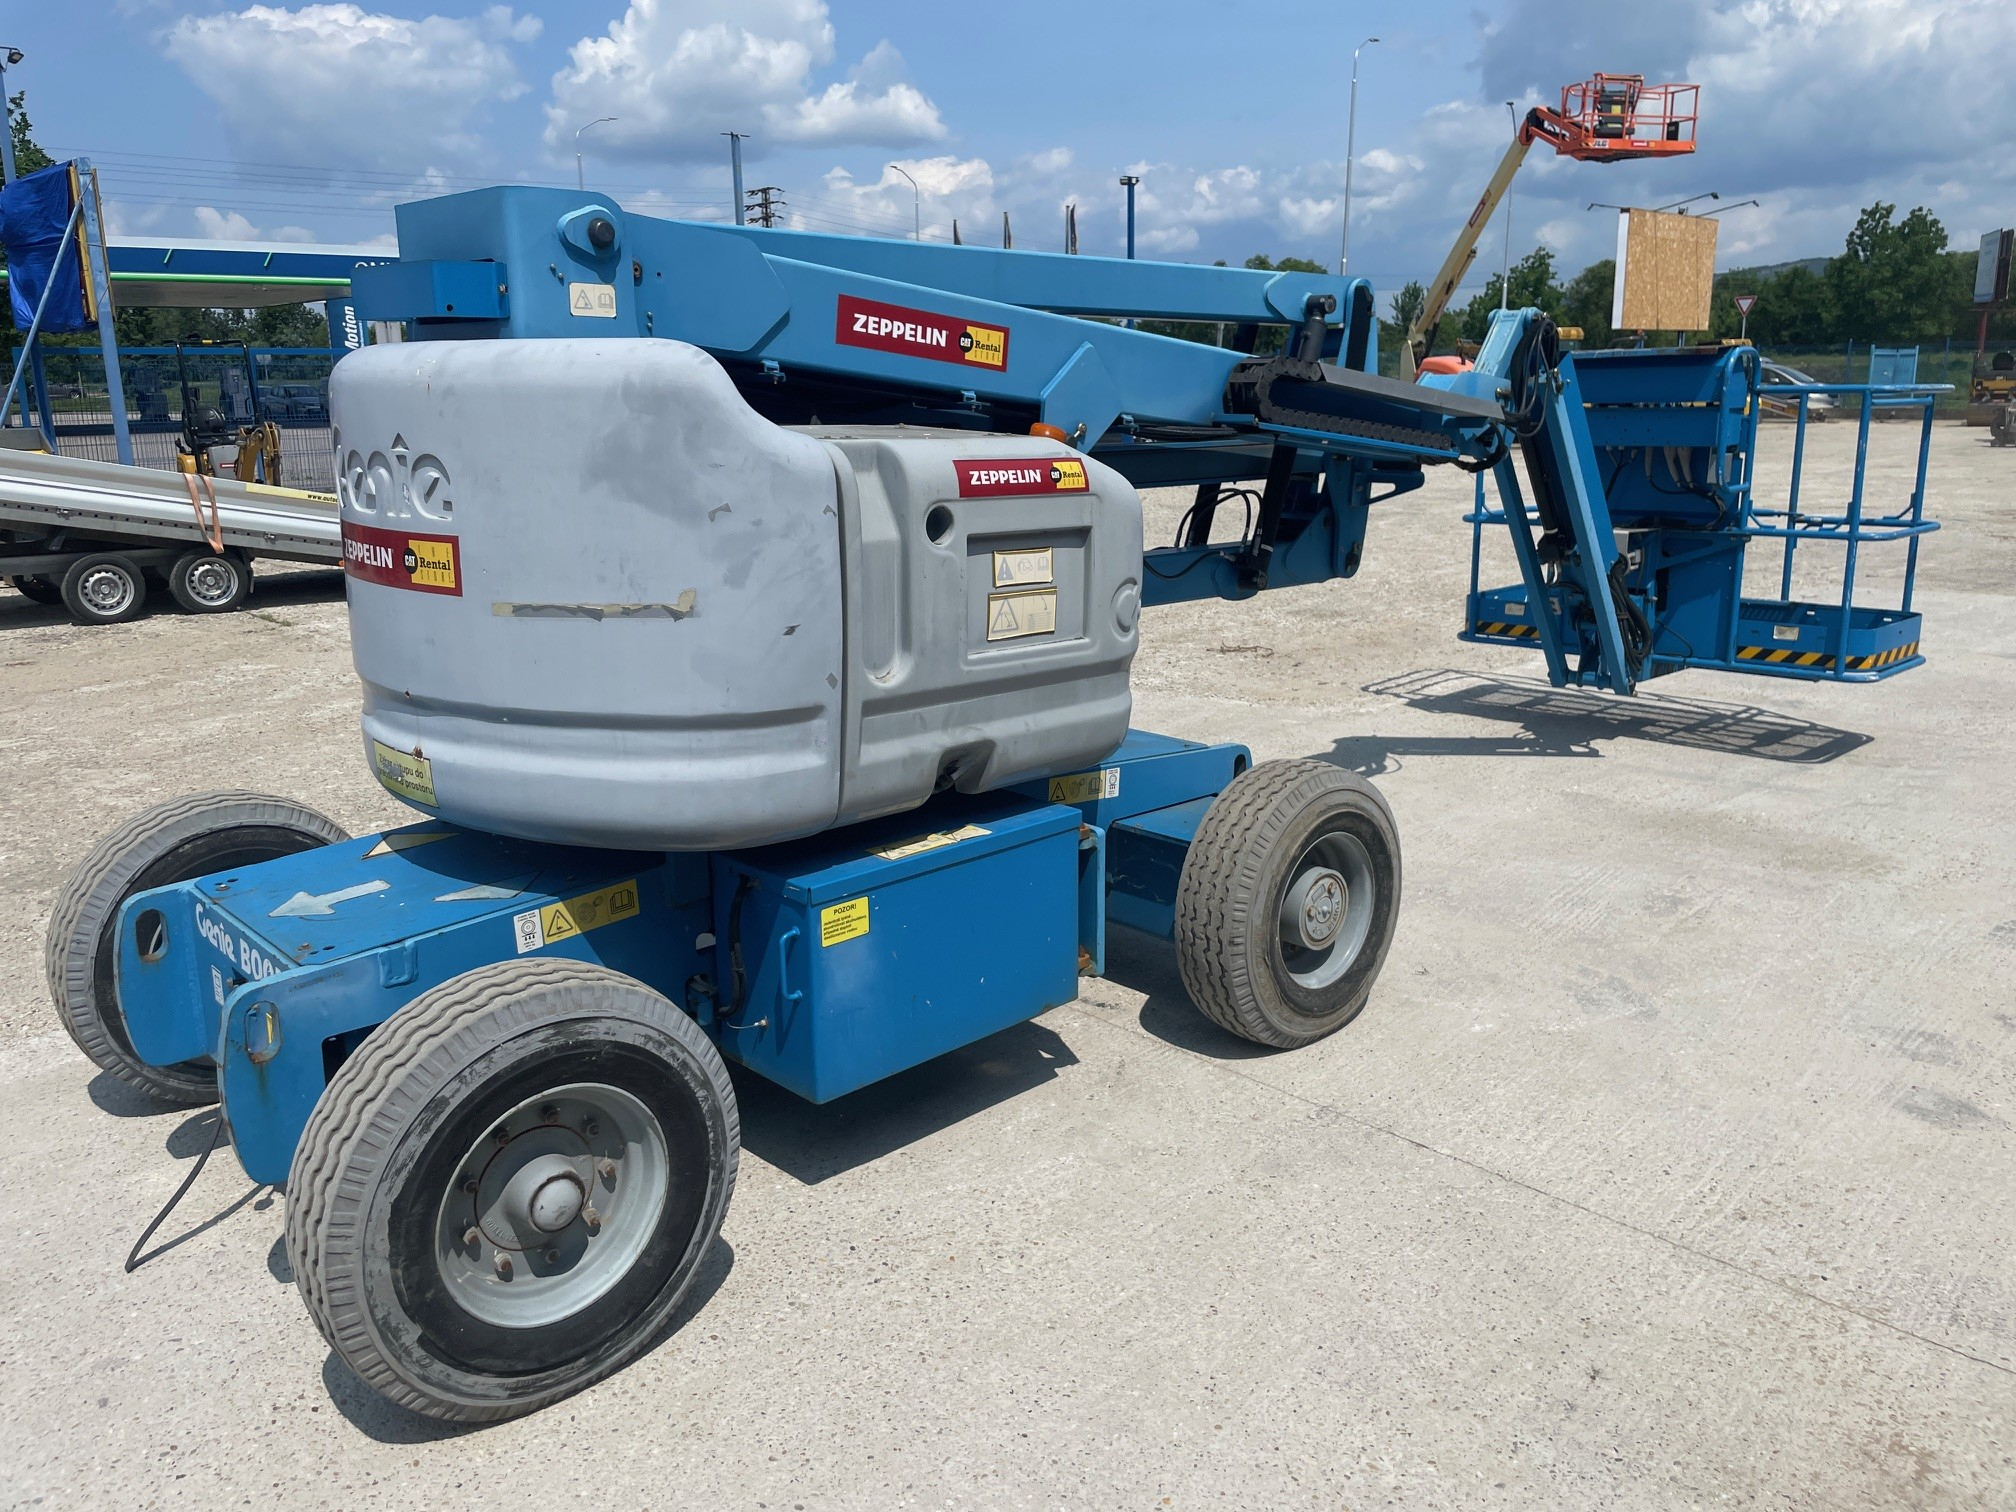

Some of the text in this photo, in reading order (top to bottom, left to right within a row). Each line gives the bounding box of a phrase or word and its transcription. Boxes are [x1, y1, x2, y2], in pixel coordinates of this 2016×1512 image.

[853, 313, 947, 348] ZEPPELIN
[960, 336, 1001, 353] CAT Rental
[968, 469, 1042, 486] ZEPPELIN
[1062, 471, 1083, 479] Rental
[344, 538, 393, 569] ZEPPELIN
[404, 554, 451, 571] CAT Rental
[414, 768, 424, 779] do
[405, 780, 434, 795] prostoru
[833, 903, 857, 916] POZOR!
[195, 902, 282, 980] Genie BOO
